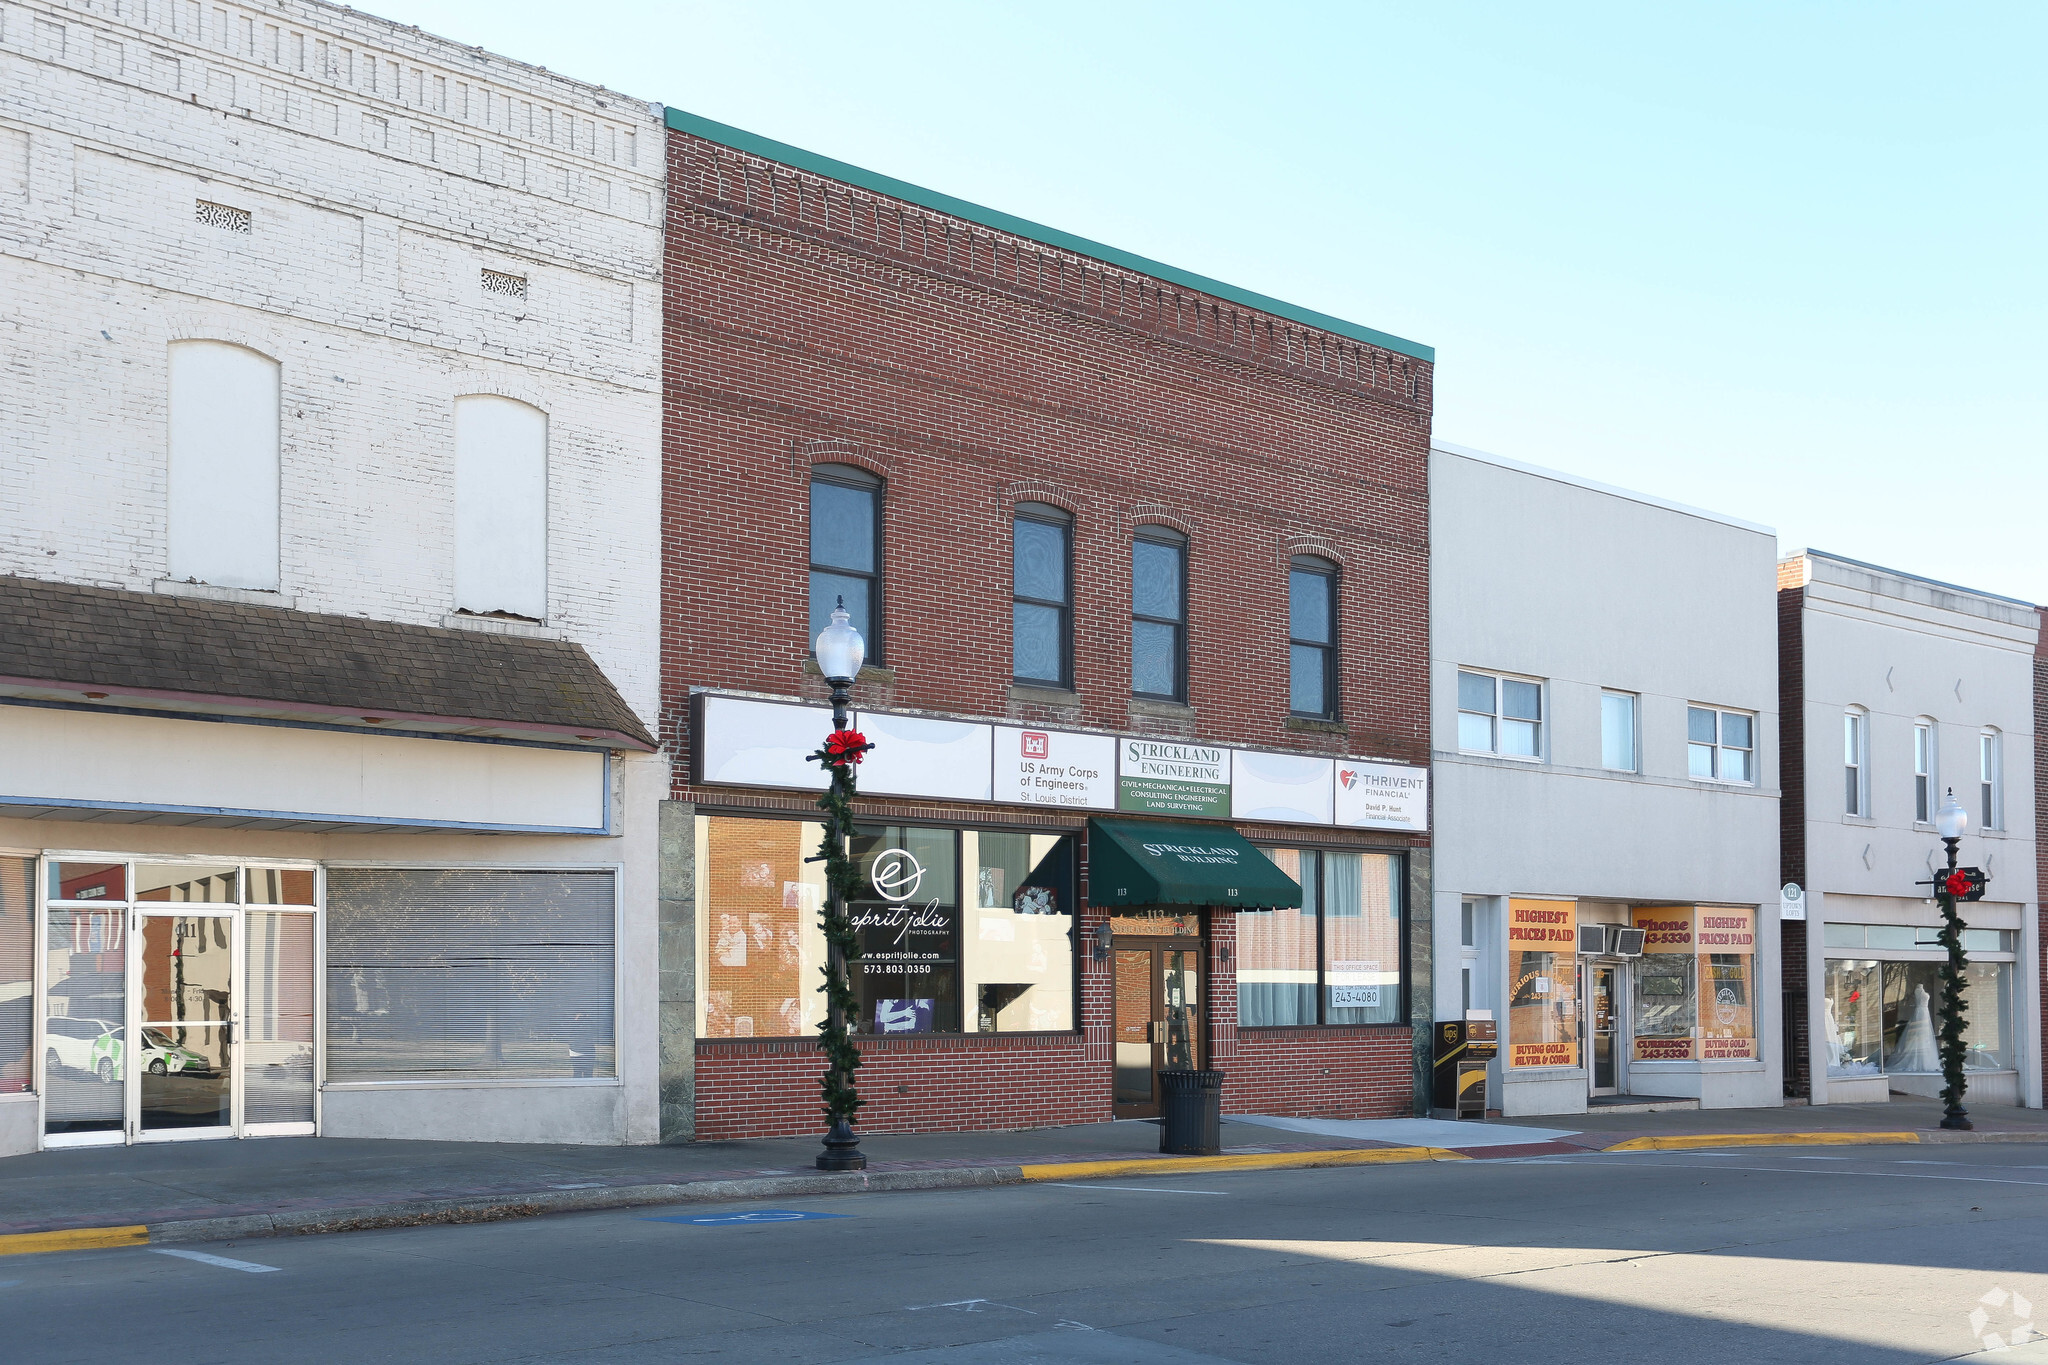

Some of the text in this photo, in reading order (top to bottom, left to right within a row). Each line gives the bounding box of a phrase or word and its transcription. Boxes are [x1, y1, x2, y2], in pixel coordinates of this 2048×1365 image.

[1129, 742, 1220, 762] STRICKLAND
[1020, 762, 1098, 779] US Army Corps
[1141, 763, 1219, 779] ENGINEERING
[1020, 776, 1031, 786] of
[1364, 775, 1424, 789] THRIVENT
[1020, 792, 1088, 805] St. Louis District
[1130, 791, 1218, 803] CONSULTING ENGINEERING
[1366, 789, 1409, 799] FINANCIAL
[1167, 803, 1203, 811] SURVEYING
[1365, 803, 1381, 811] David
[1365, 813, 1411, 823] Financial Associate
[1143, 843, 1239, 857] STRICKLAND
[1177, 854, 1238, 864] BUILDING
[1117, 888, 1127, 896] 113
[1227, 888, 1238, 897] 113
[1787, 888, 1797, 898] 121
[1147, 909, 1165, 923] 113
[1515, 910, 1568, 924] HIGHEST
[851, 898, 950, 945] sprit jolie
[1637, 918, 1689, 931] Phone
[1703, 917, 1747, 929] HIGHEST
[1163, 924, 1197, 935] BUILDING
[1509, 927, 1574, 941] PRICES PAID
[1643, 932, 1691, 944] 43-5330
[1699, 933, 1753, 945] PRICES PAID
[861, 952, 940, 960] ww.espritjolie.com
[864, 964, 931, 974] 573.803.0350
[1730, 967, 1744, 979] GOLD
[1509, 970, 1540, 1001] CURIOUS
[1335, 992, 1377, 1002] 243-4080
[1444, 1030, 1457, 1040] ups
[1516, 1044, 1565, 1054] BUYING GOLD
[1705, 1040, 1746, 1048] BUYING GOLD
[1641, 1049, 1690, 1059] 243-5330
[1704, 1049, 1751, 1058] SILVER & COINS
[1515, 1055, 1570, 1065] SILVER & COINS
